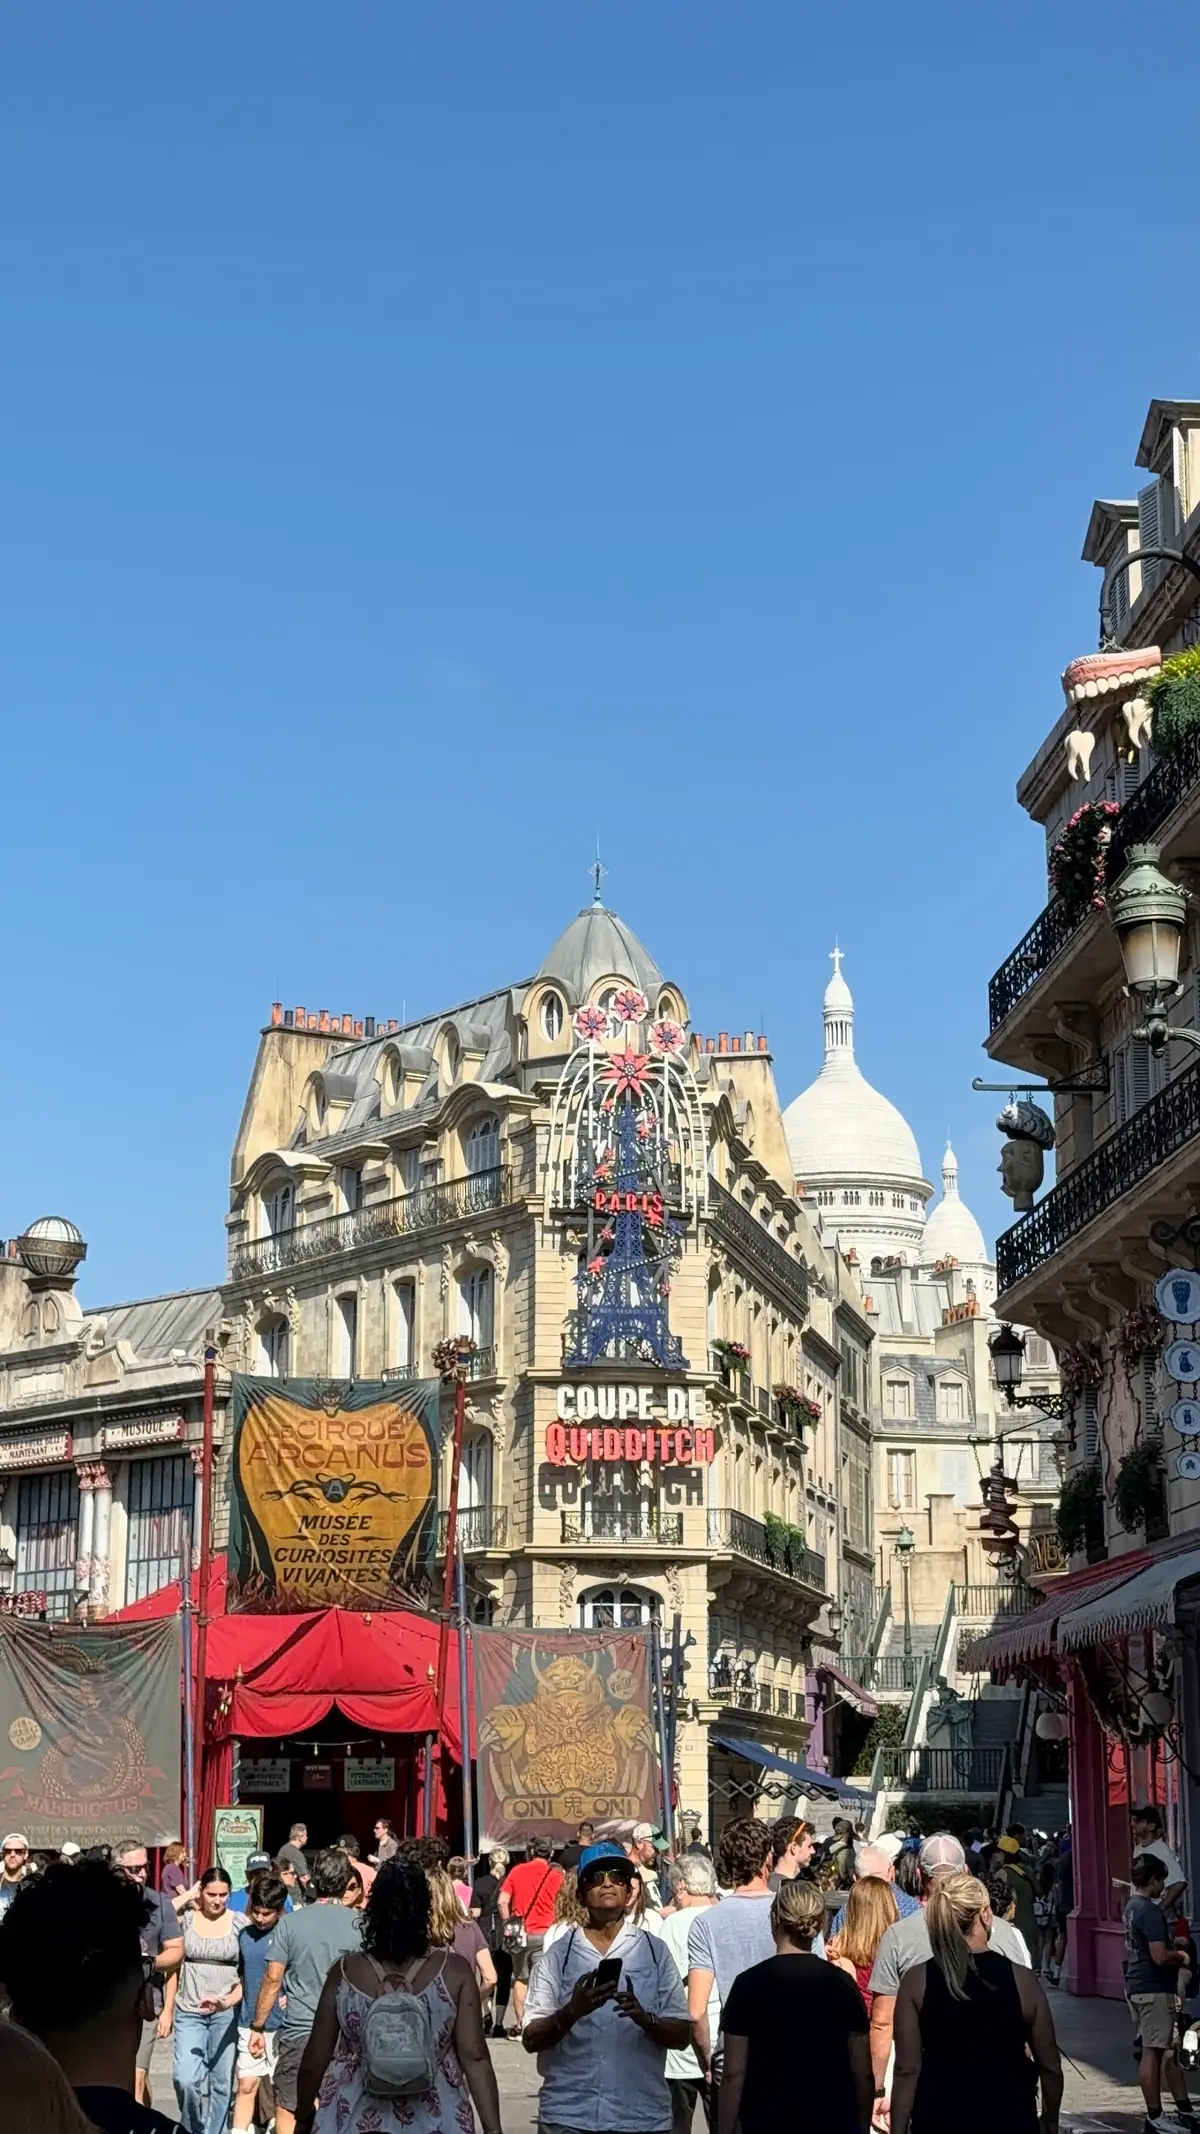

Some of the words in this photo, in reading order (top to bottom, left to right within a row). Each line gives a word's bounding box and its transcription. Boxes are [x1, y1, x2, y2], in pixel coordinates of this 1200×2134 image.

[593, 1191, 664, 1211] PARIS
[556, 1384, 654, 1421] COUPE
[667, 1384, 706, 1421] DE
[121, 1420, 164, 1437] MUSIQUE
[296, 1419, 406, 1441] CIRQUE
[9, 1446, 47, 1459] MAINTENANT
[545, 1421, 715, 1466] QUIDDITCH
[246, 1441, 428, 1469] ARCANUS
[326, 1480, 344, 1498] A
[299, 1513, 372, 1532] MUSÉE
[318, 1534, 350, 1546] DES
[274, 1546, 393, 1564] CURIOSITÉS
[282, 1567, 383, 1587] VIVANTES
[24, 1794, 140, 1818] MALEDICTUS
[512, 1799, 553, 1817] ONI
[564, 1795, 585, 1819] 鬼
[593, 1798, 633, 1817] ONI
